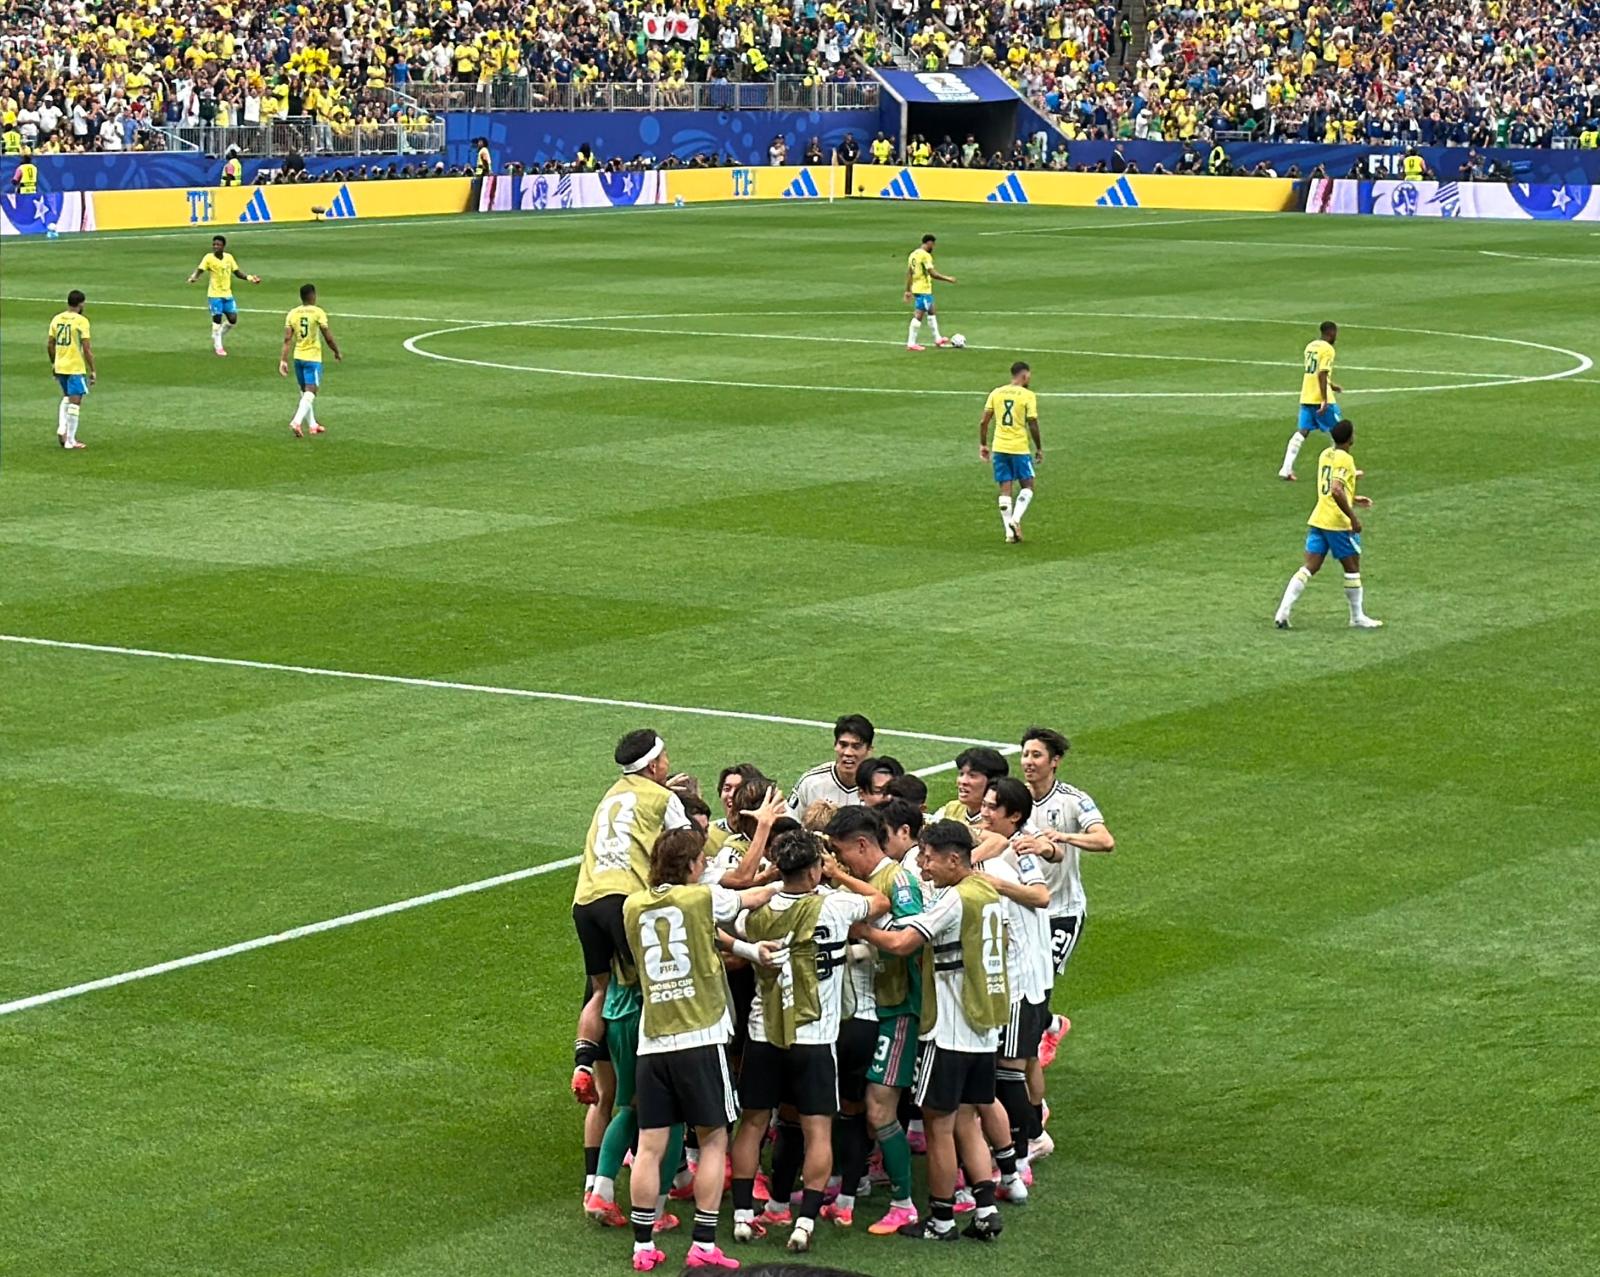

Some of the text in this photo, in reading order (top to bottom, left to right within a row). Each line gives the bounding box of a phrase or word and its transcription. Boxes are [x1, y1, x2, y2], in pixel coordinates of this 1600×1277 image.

[56, 323, 72, 346] 20
[300, 317, 308, 338] 5
[1002, 399, 1014, 426] 8
[1051, 928, 1072, 954] 21
[659, 964, 680, 974] FIFA
[648, 978, 694, 992] WORLD CUP
[649, 986, 696, 1004] 2026
[873, 1034, 891, 1062] 3
